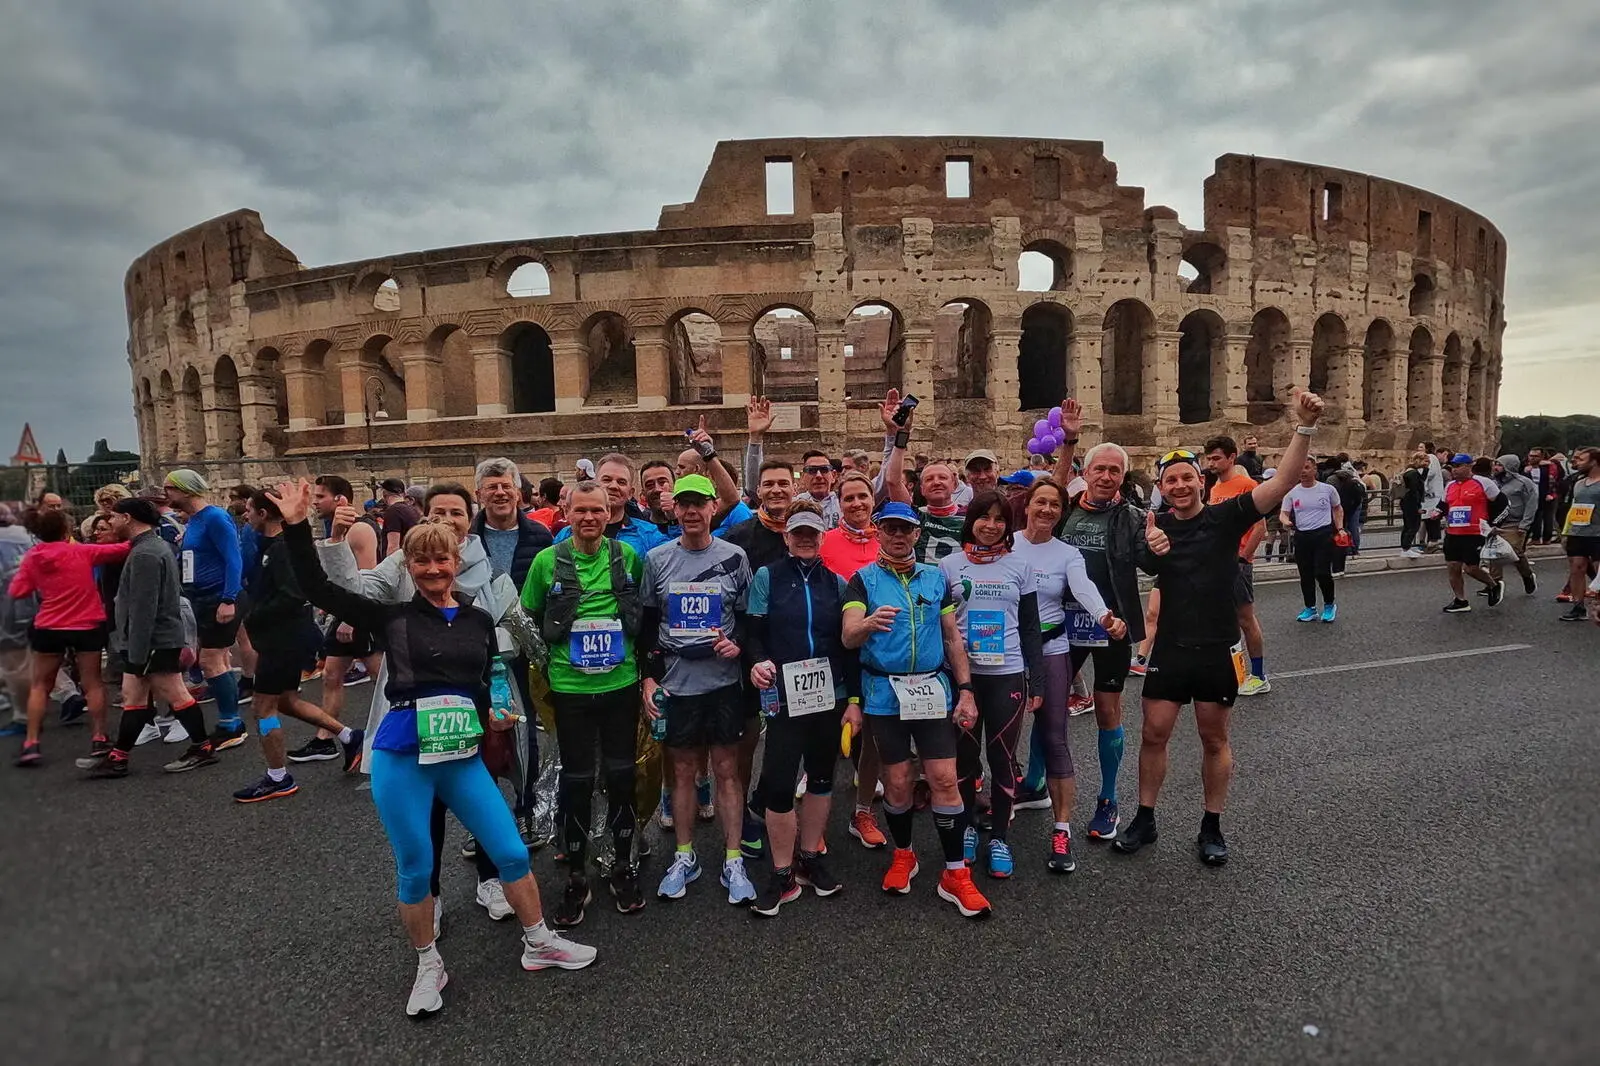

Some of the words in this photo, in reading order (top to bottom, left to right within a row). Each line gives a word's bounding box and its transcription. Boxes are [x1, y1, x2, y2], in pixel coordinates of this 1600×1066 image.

[975, 583, 1010, 591] LANDKREIS
[975, 589, 1002, 597] GÖRLITZ
[681, 596, 709, 614] 8230
[699, 620, 707, 628] C
[582, 633, 612, 653] 8419
[602, 658, 610, 666] C
[794, 670, 826, 692] F2779
[797, 697, 807, 707] F4
[817, 695, 824, 703] D
[910, 703, 917, 711] 12
[927, 702, 934, 711] D
[429, 711, 473, 735] F2792
[432, 742, 444, 753] F4
[458, 740, 466, 749] B
